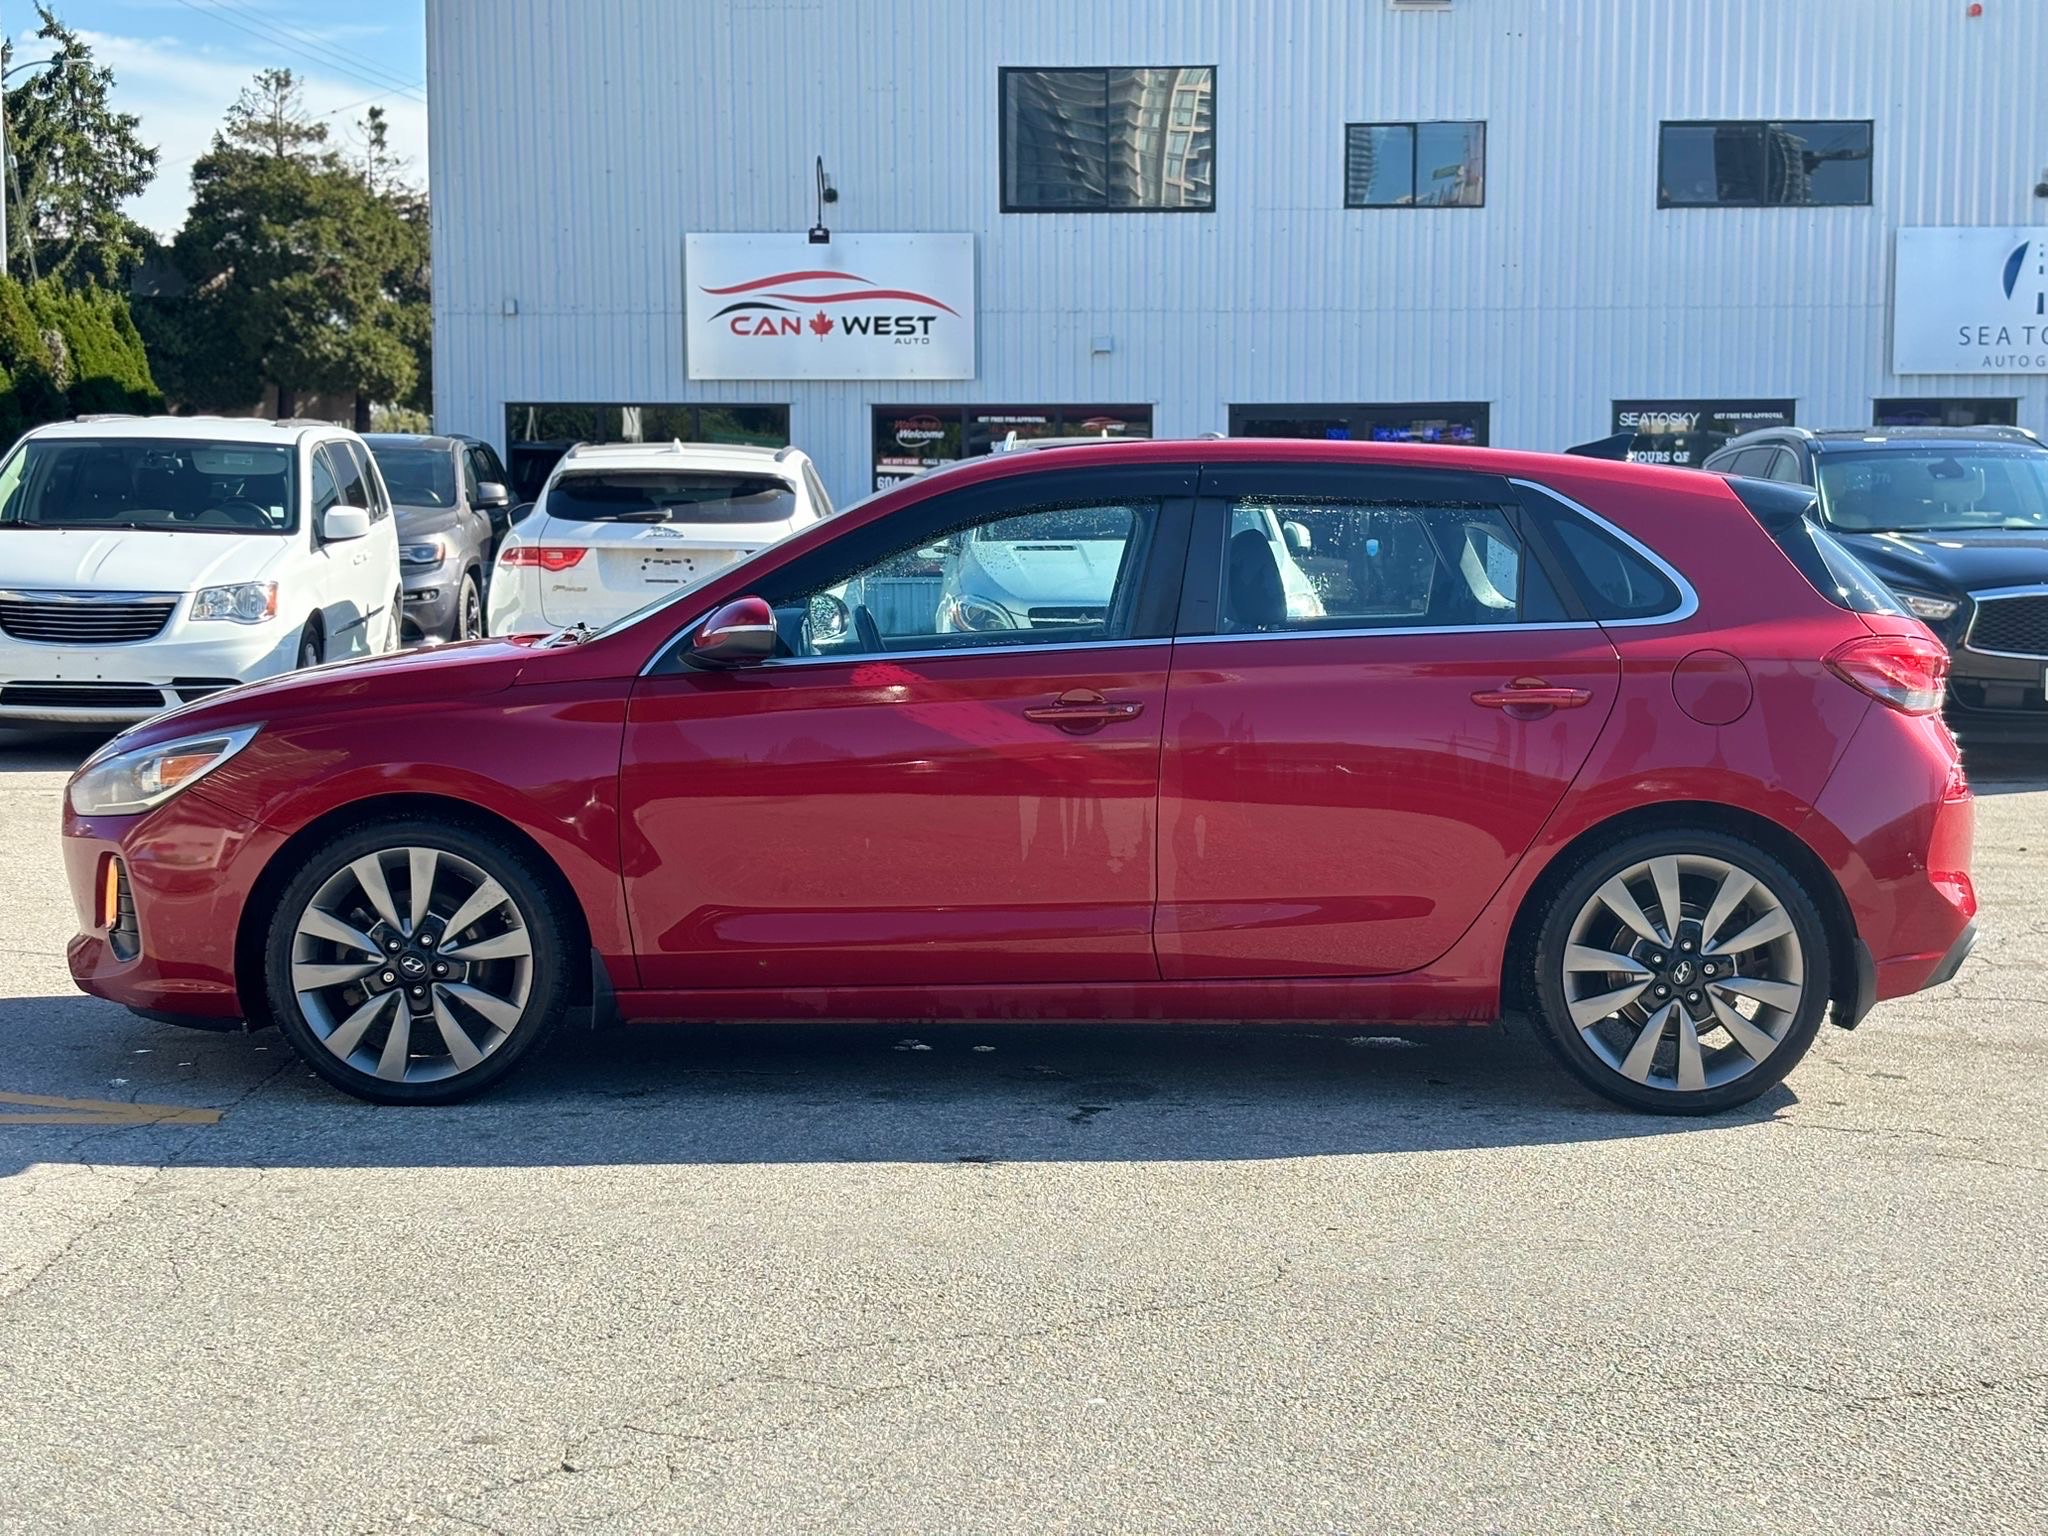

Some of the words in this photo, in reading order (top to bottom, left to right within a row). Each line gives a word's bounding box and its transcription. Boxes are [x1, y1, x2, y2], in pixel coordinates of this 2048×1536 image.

[730, 316, 801, 336] CAN
[841, 316, 937, 336] WEST
[894, 337, 930, 345] AUTO
[1982, 355, 2030, 368] AUTO
[1618, 412, 1700, 427] SEATOSKY
[899, 429, 945, 439] Welcome
[1672, 450, 1690, 463] OF
